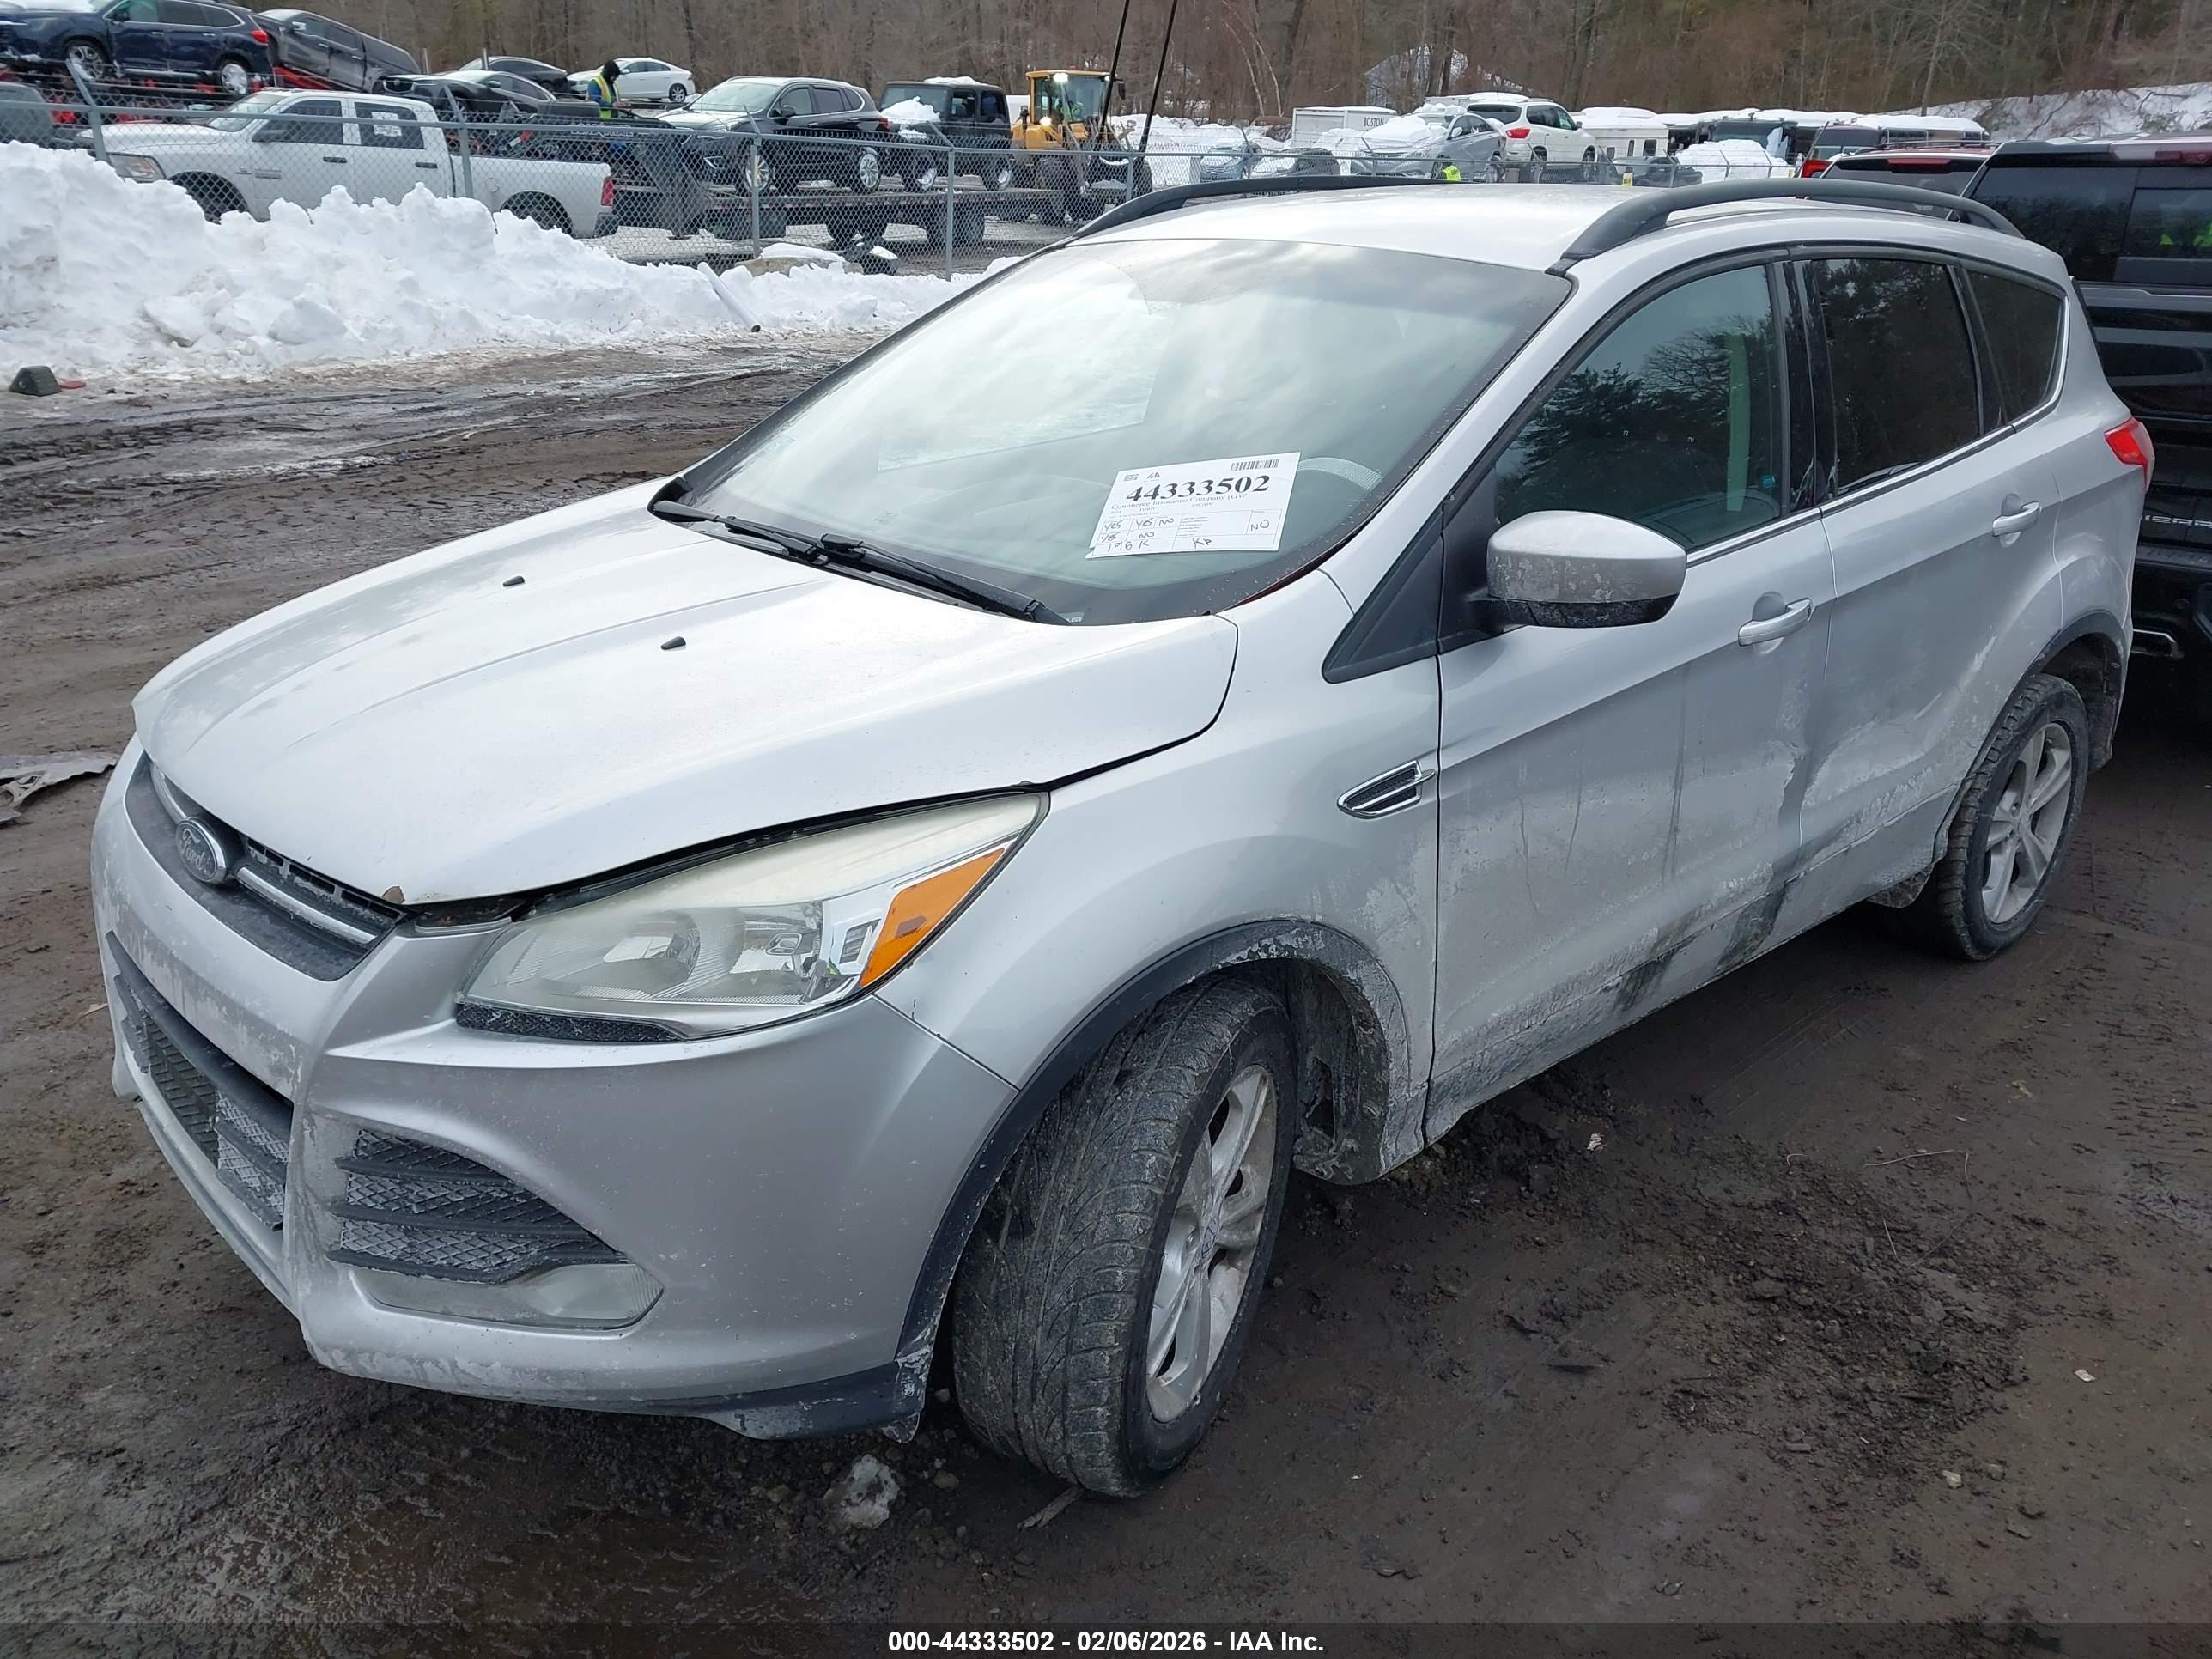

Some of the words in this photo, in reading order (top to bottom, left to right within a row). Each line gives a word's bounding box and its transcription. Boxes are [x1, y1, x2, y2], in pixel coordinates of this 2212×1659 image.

[1364, 117, 1384, 127] BOSTON
[1126, 475, 1270, 502] 44333502
[1250, 519, 1270, 532] NO
[179, 828, 210, 872] Ford
